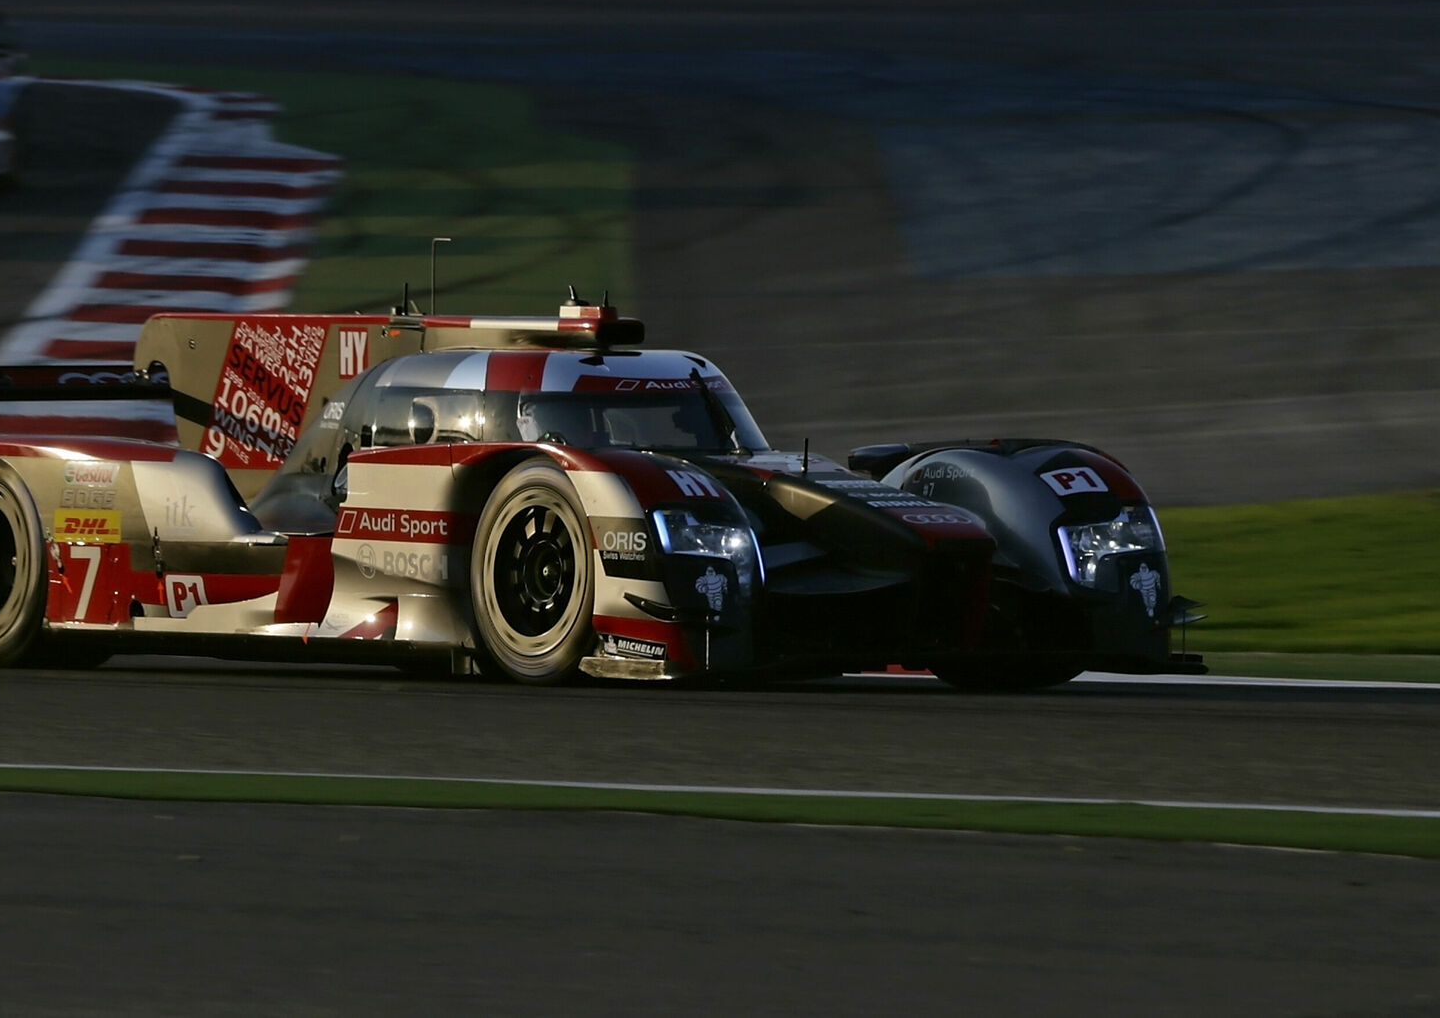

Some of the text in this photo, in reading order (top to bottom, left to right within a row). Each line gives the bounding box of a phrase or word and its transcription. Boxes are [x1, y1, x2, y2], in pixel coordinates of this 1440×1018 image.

[235, 327, 280, 377] FIA WEC
[340, 331, 367, 375] HY
[230, 344, 304, 425] SERVUS
[645, 380, 691, 390] Audi
[218, 377, 260, 434] 106
[214, 402, 254, 452] WINS
[206, 425, 226, 458] 9
[923, 467, 944, 479] Audi
[1052, 471, 1098, 490] P1
[62, 489, 116, 509] EDGE
[64, 518, 110, 535] DHL
[360, 512, 448, 538] Audi Sport
[603, 531, 647, 551] ORIS
[603, 551, 619, 560] Swiss
[70, 546, 101, 619] 7
[172, 581, 201, 612] P1
[618, 639, 664, 656] MICHELIN
